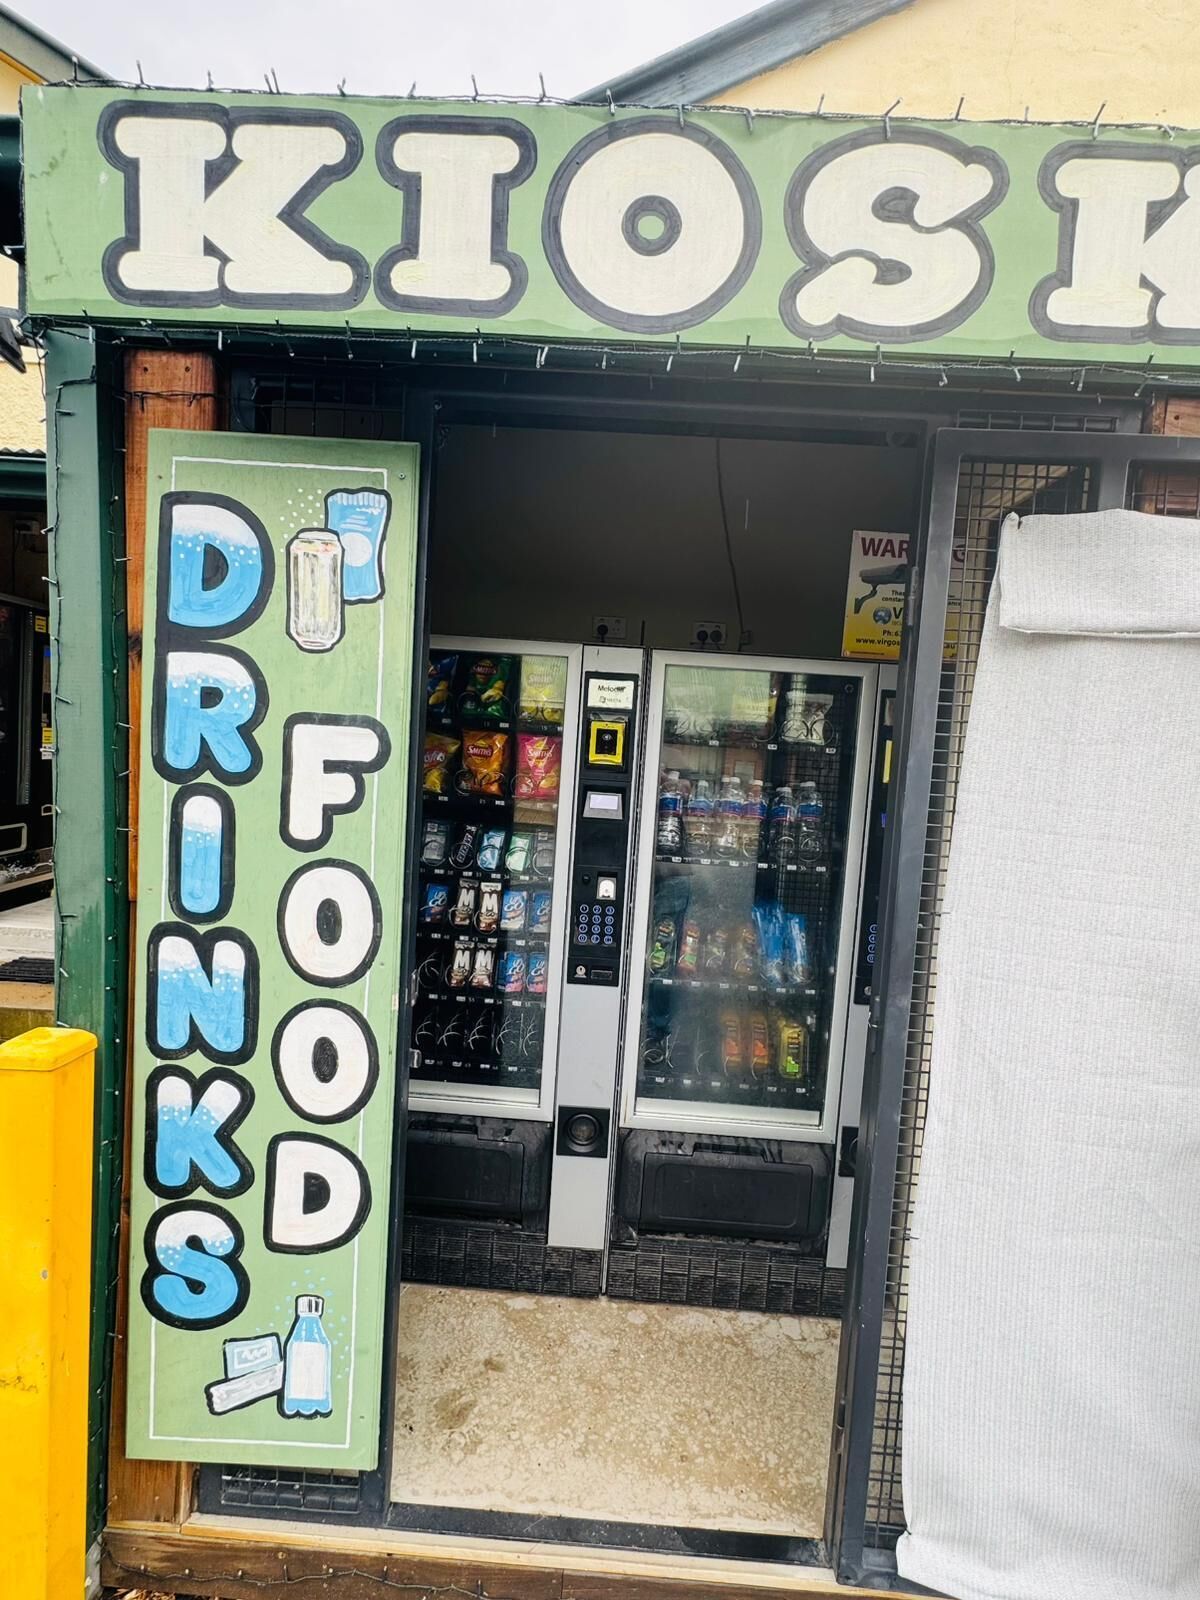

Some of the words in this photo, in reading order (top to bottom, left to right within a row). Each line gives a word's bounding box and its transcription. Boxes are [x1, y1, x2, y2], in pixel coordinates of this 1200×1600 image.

[98, 101, 1200, 347] KIOSK
[142, 491, 276, 1331] DRINKS
[263, 712, 392, 1255] FOOD
